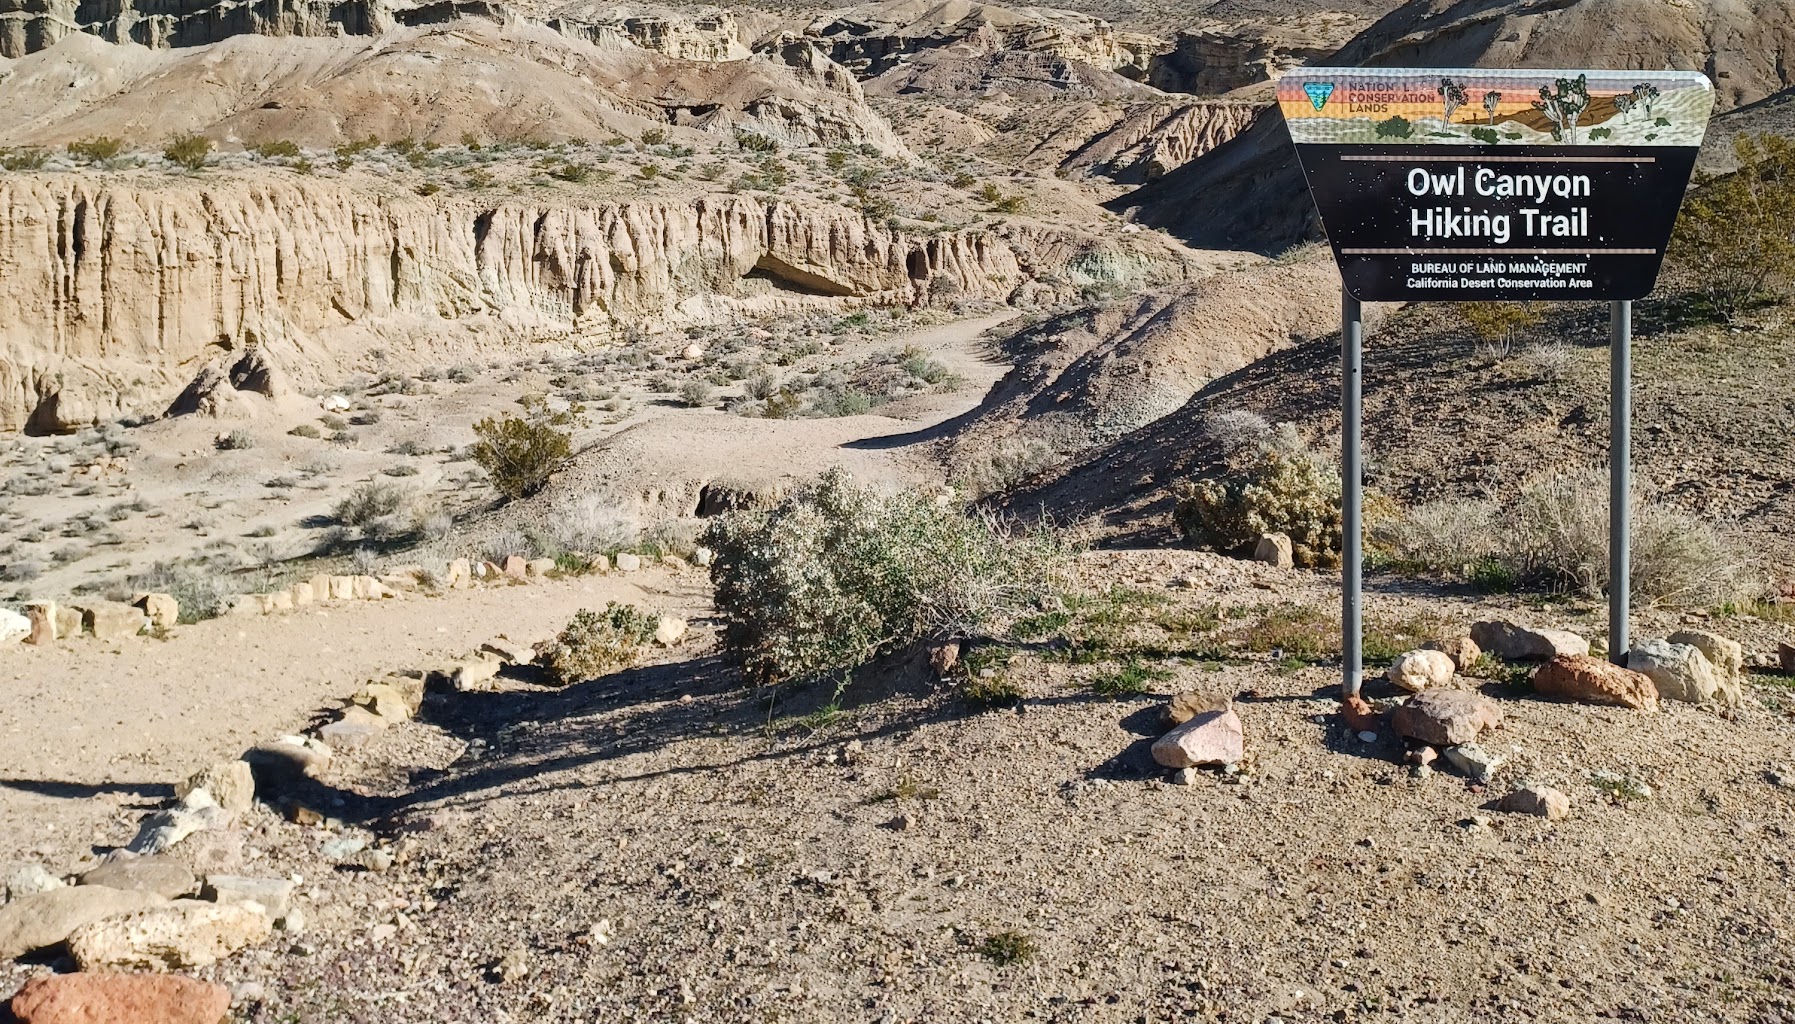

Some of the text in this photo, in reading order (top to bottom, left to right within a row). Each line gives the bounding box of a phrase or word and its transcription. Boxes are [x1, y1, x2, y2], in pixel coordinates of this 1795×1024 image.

[1349, 82, 1410, 92] NATIONL
[1349, 93, 1435, 103] CONSERVATION
[1349, 104, 1388, 113] LANDS
[1407, 166, 1591, 204] Owl Canyon
[1411, 207, 1588, 244] Hiking Trail
[1411, 263, 1587, 274] BUREAU OF LAND MANAGEMENT
[1407, 277, 1593, 289] California Desert Conservation Area
